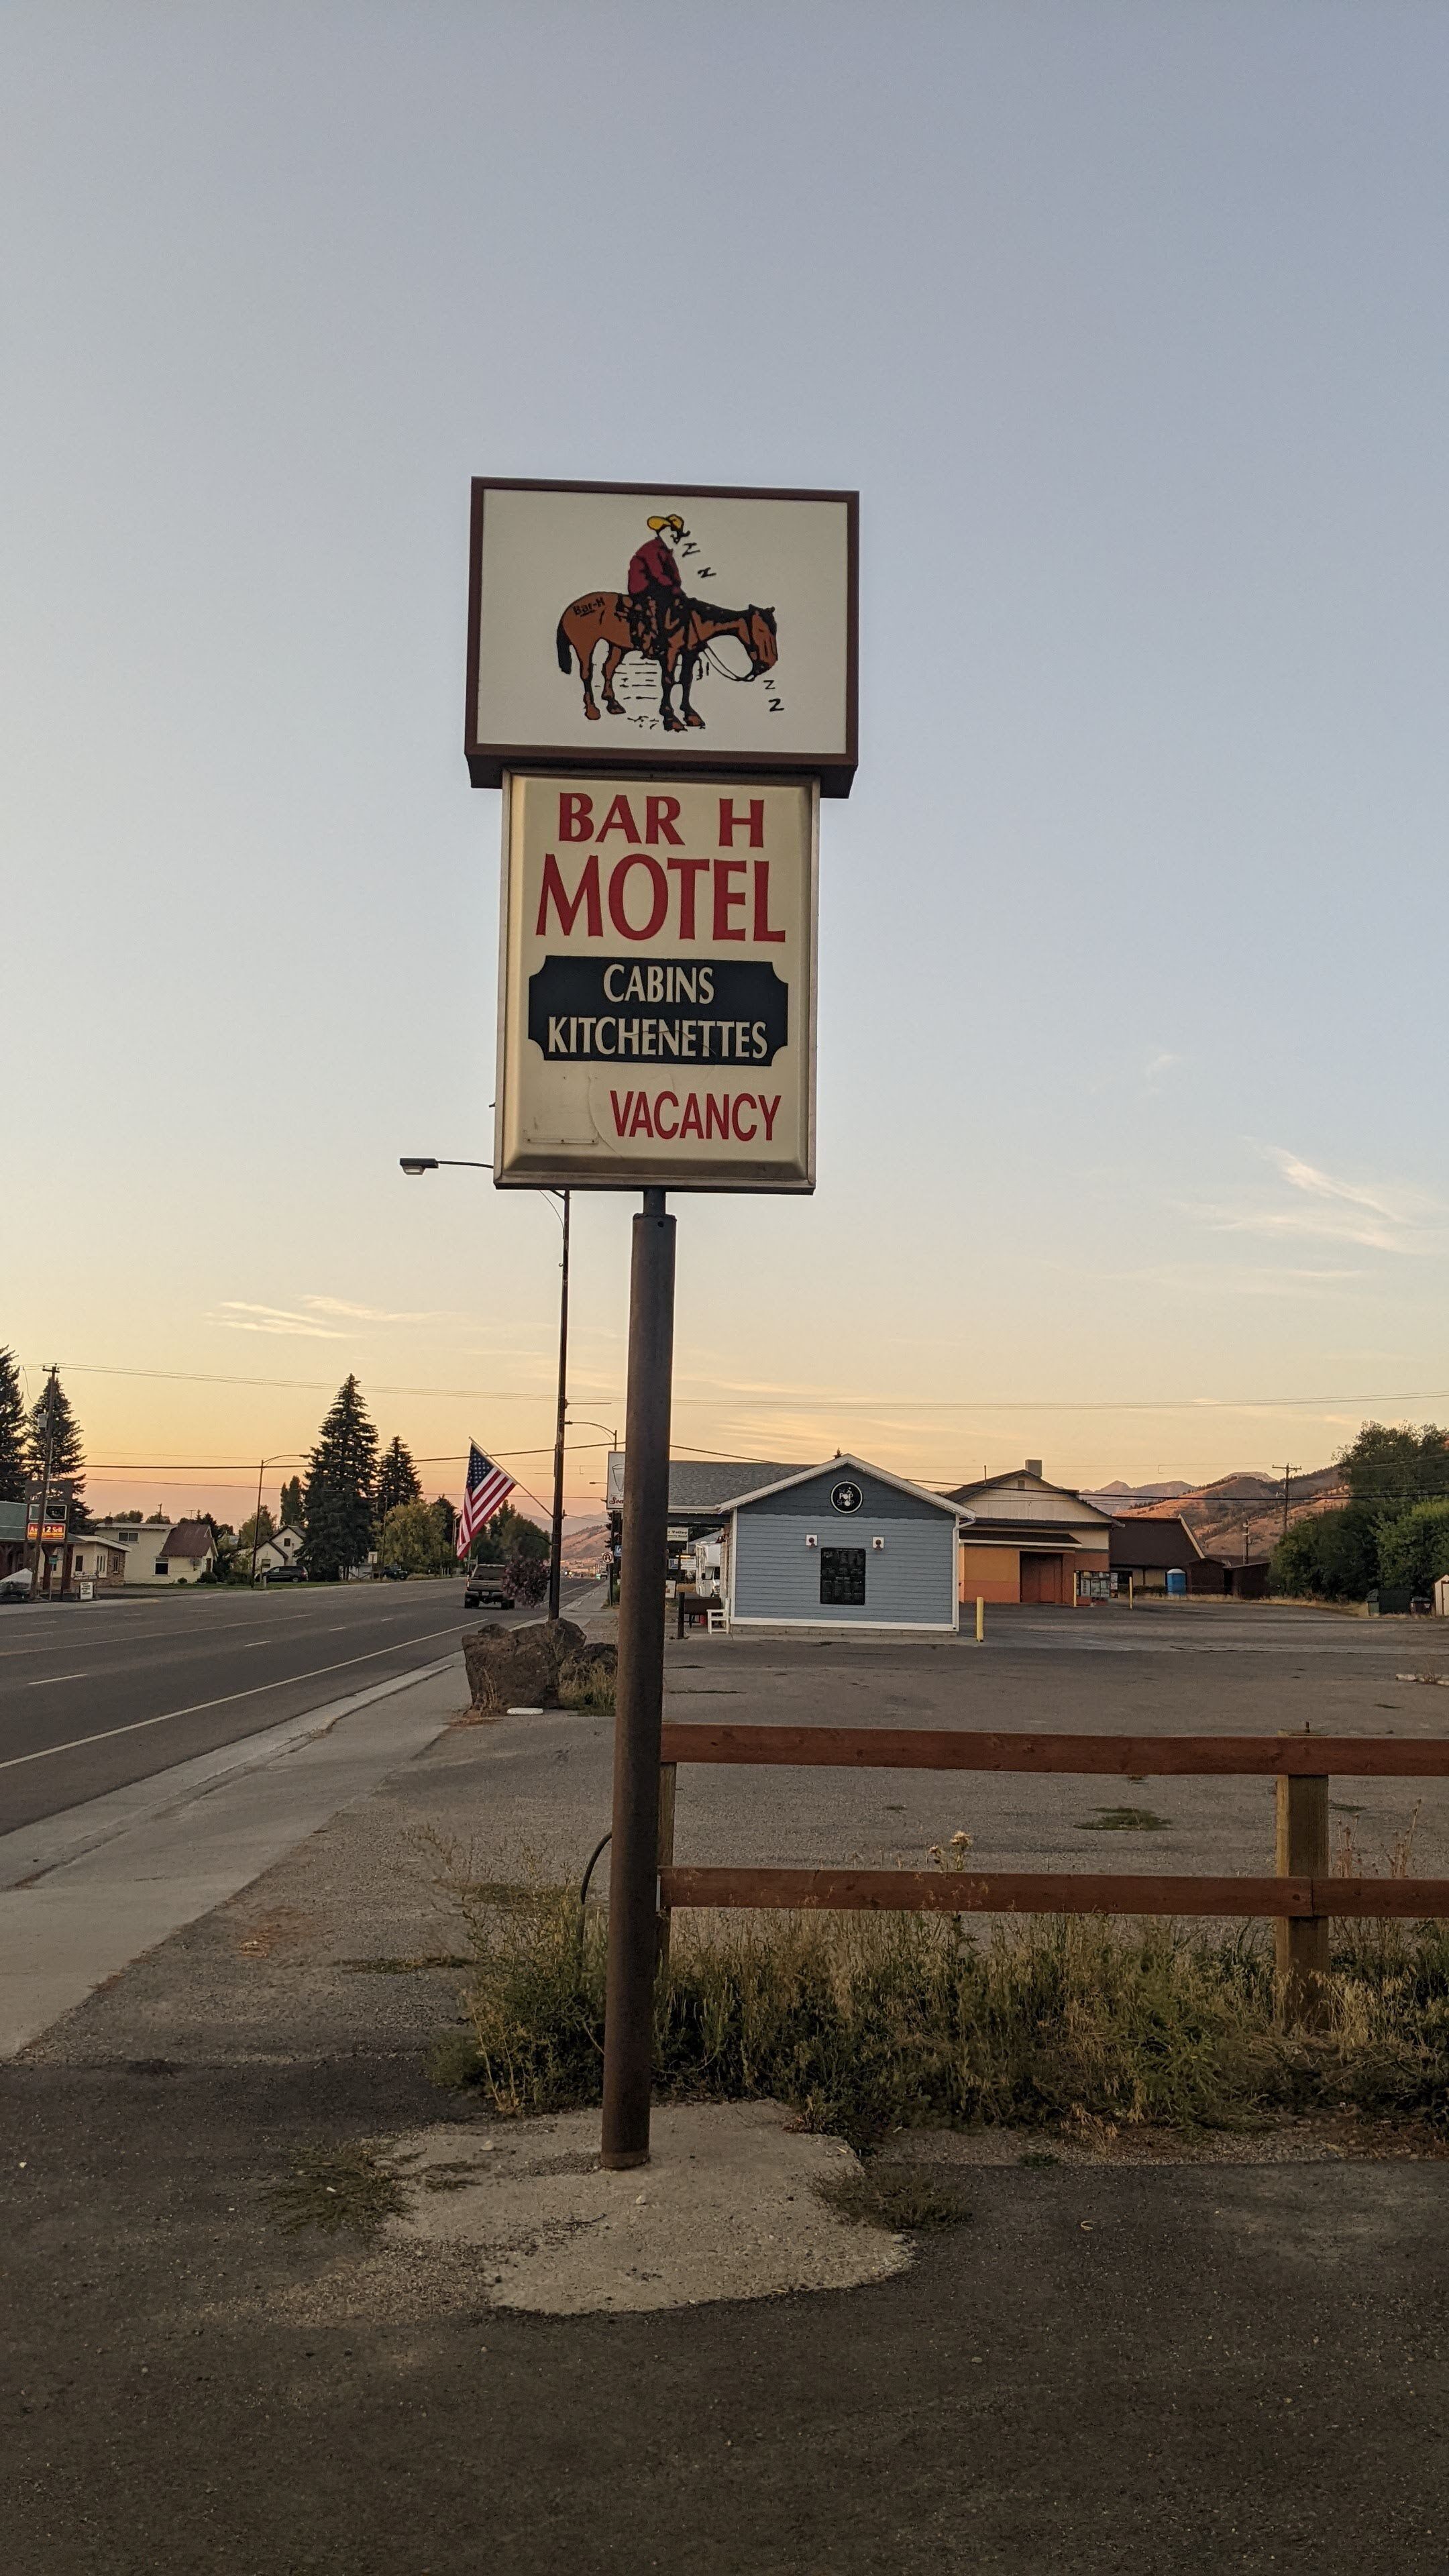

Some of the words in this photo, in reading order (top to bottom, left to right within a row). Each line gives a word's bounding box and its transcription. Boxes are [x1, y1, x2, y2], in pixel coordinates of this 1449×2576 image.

[558, 792, 685, 846] BAR
[718, 798, 764, 847] H
[536, 853, 786, 942] MOTEL
[604, 963, 714, 1004] CABINS
[548, 1016, 768, 1059] KITCHENETTES
[609, 1090, 782, 1142] VACANCY
